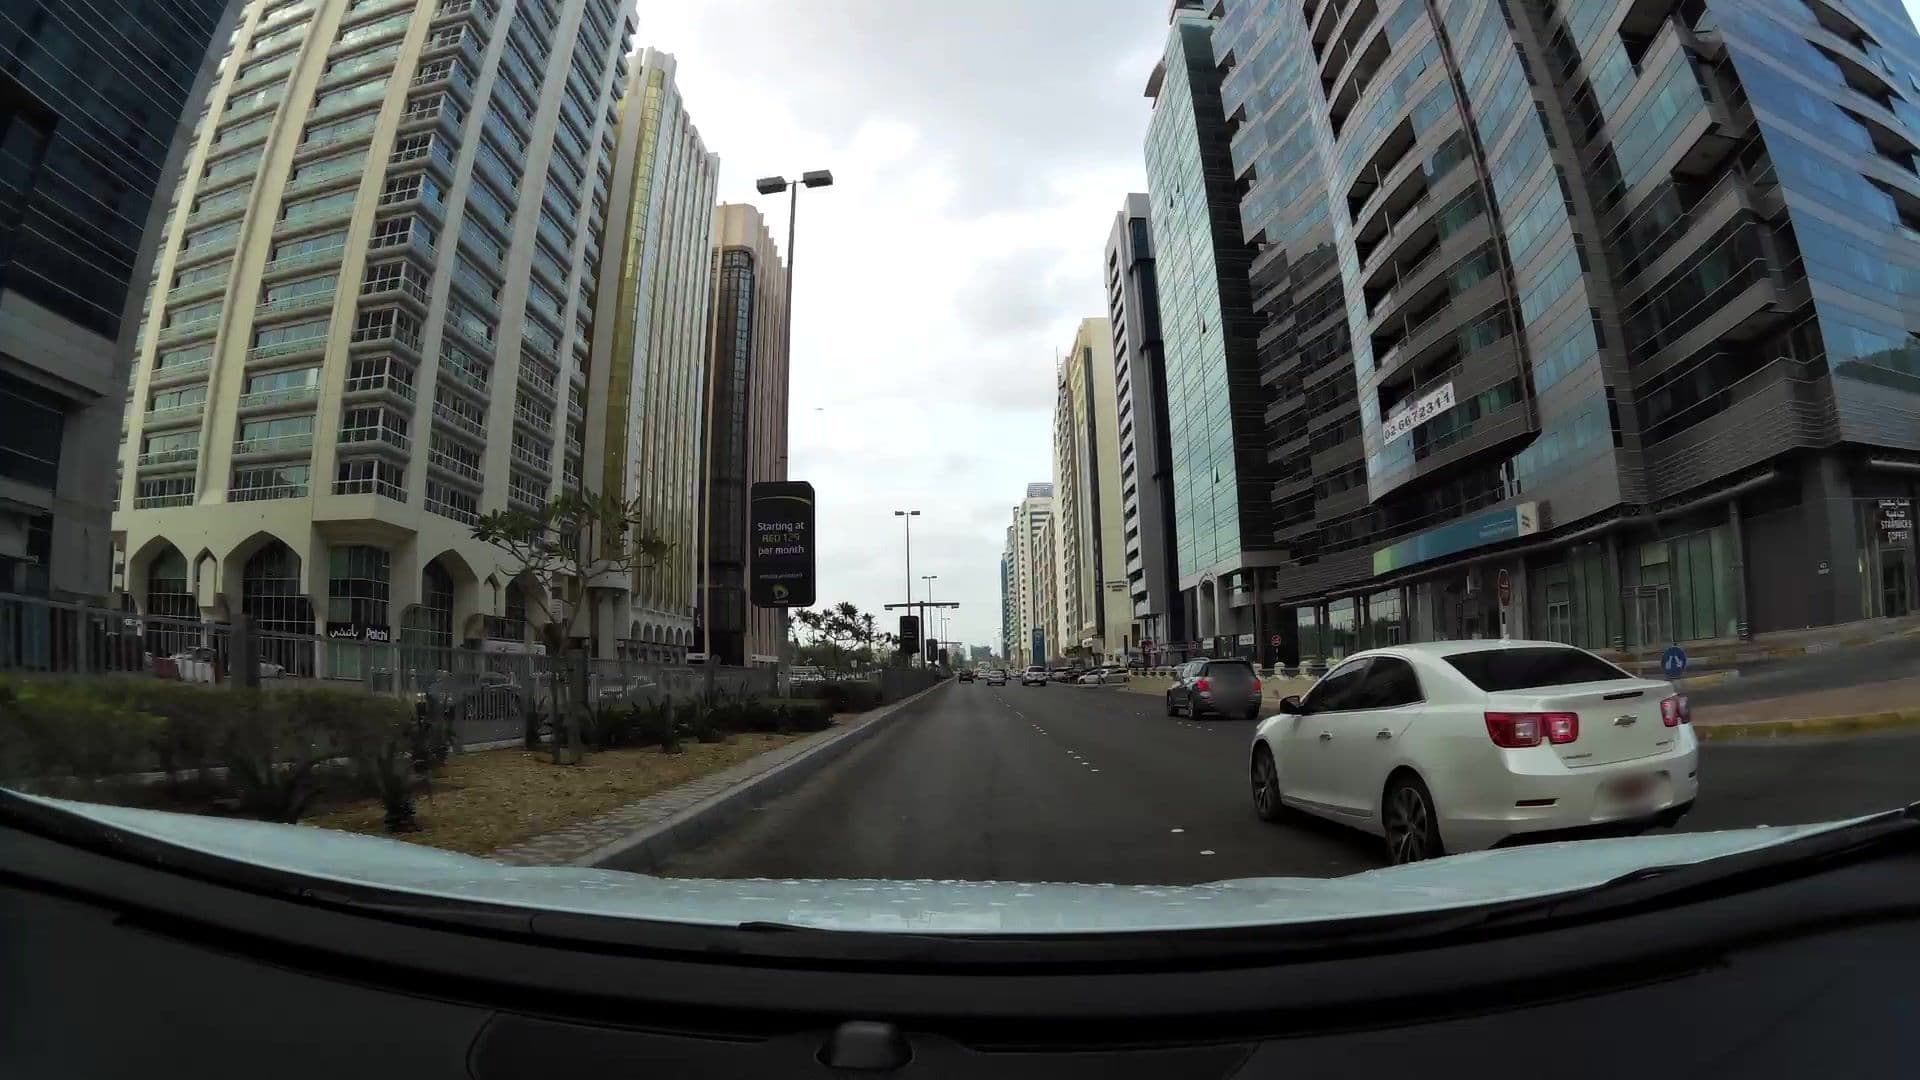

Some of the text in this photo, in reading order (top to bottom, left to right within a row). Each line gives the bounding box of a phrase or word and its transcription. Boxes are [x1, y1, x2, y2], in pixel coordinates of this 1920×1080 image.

[1384, 426, 1396, 440] 02
[757, 521, 805, 532] Starting at
[758, 544, 805, 559] per month
